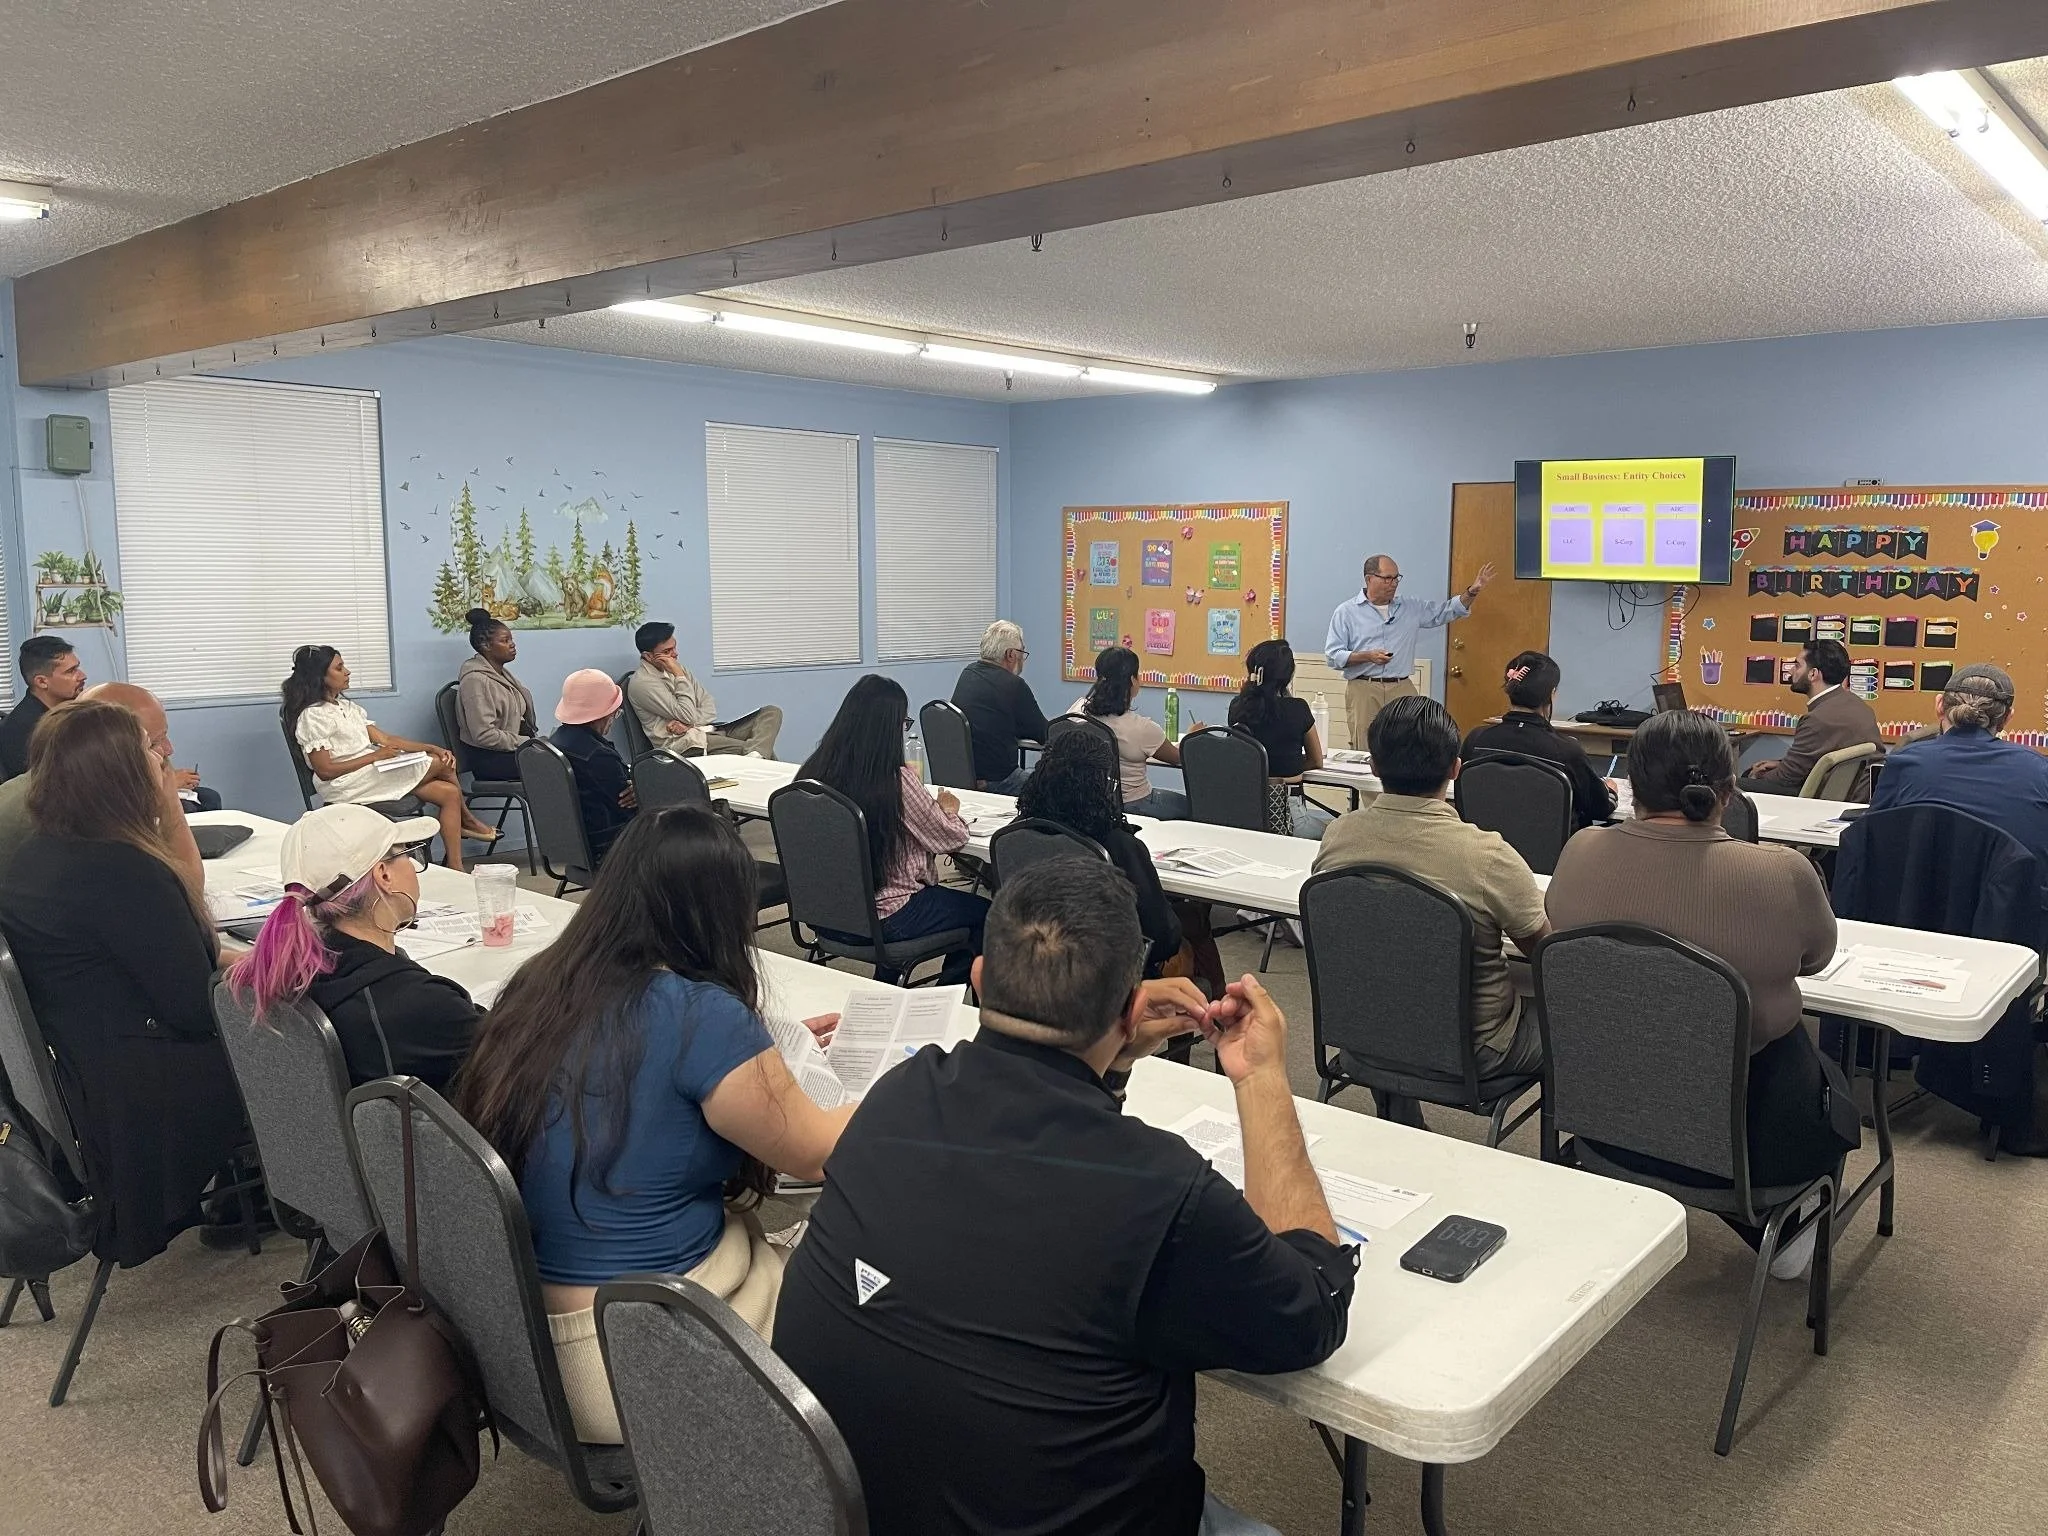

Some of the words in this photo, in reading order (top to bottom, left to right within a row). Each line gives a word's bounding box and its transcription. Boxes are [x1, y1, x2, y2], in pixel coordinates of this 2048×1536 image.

[1556, 473, 1580, 481] Small
[1582, 472, 1621, 481] Business:
[1623, 472, 1649, 482] Entity
[1652, 471, 1687, 480] Choices
[1614, 538, 1633, 546] S-Corp
[1665, 539, 1687, 547] C-Corp
[1789, 533, 1922, 551] HAPPY
[1756, 574, 1973, 593] BIRTHDAY
[1151, 617, 1170, 627] GOD
